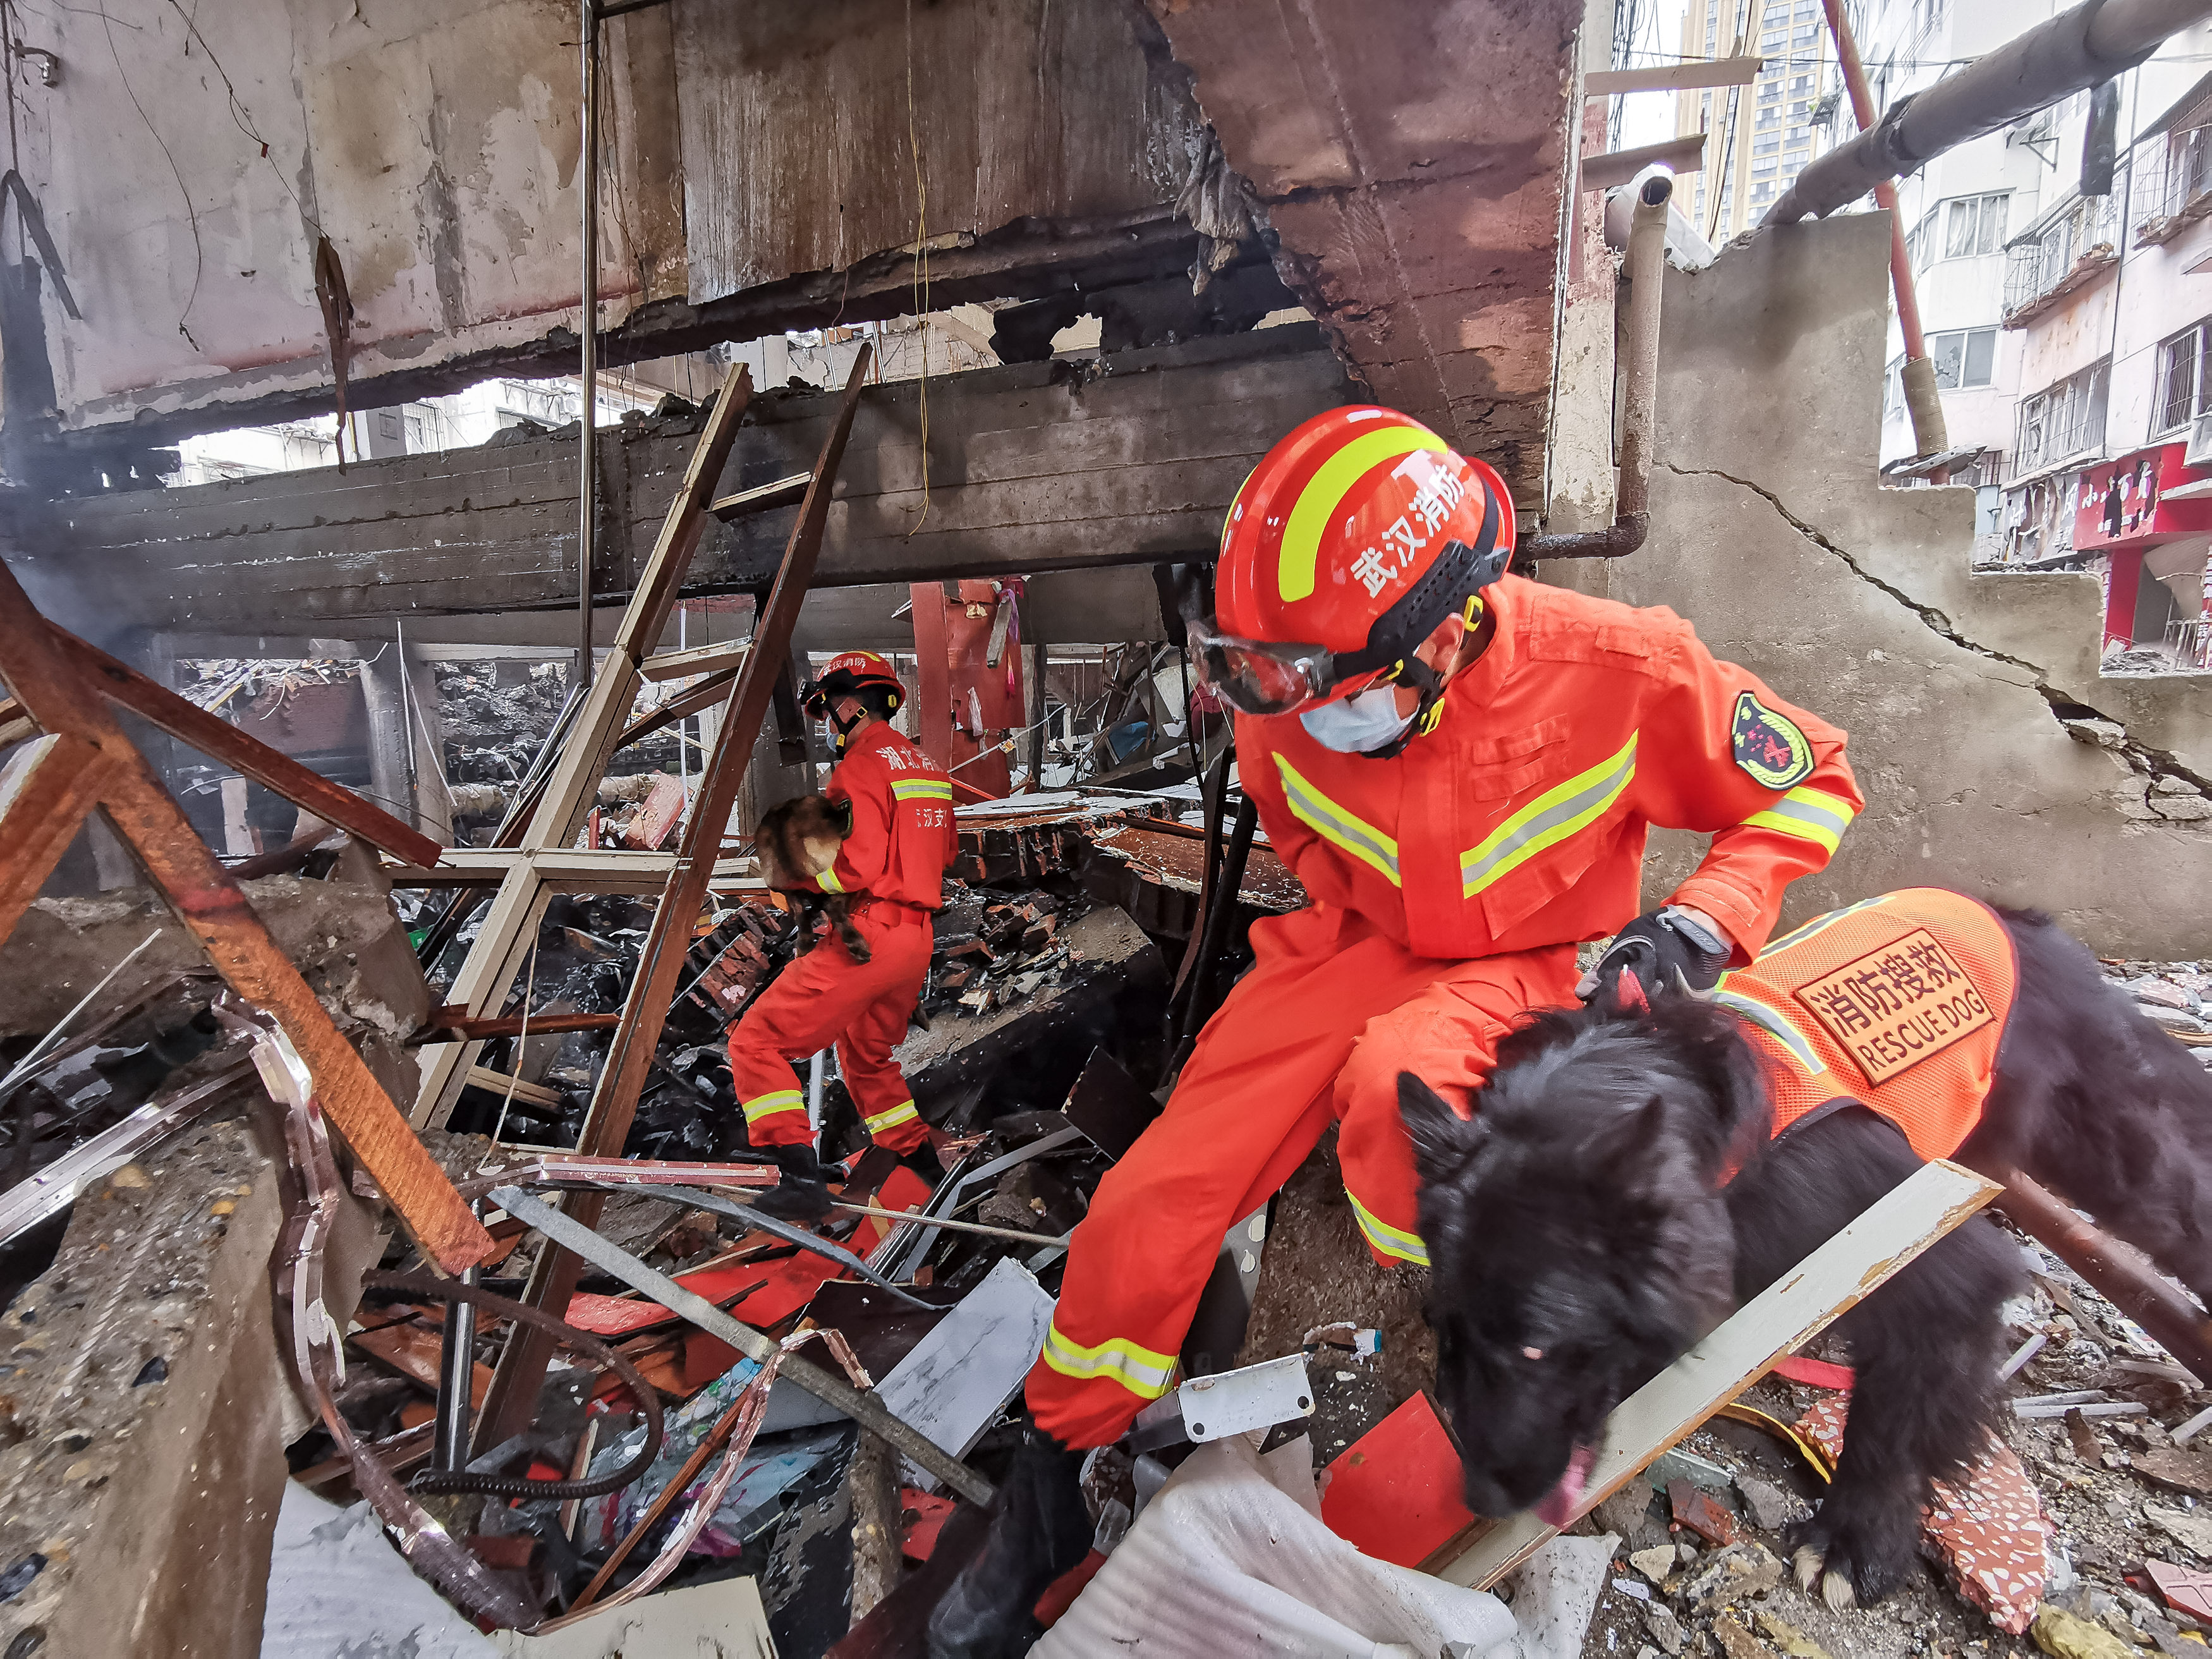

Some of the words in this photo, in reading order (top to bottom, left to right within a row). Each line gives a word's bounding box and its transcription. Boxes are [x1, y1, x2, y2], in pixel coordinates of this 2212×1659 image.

[1349, 464, 1465, 599] 武汉消防
[1809, 940, 1962, 1037] 消防搜救
[1856, 1009, 1948, 1072] RESCUE
[1936, 988, 1986, 1029] DOG
